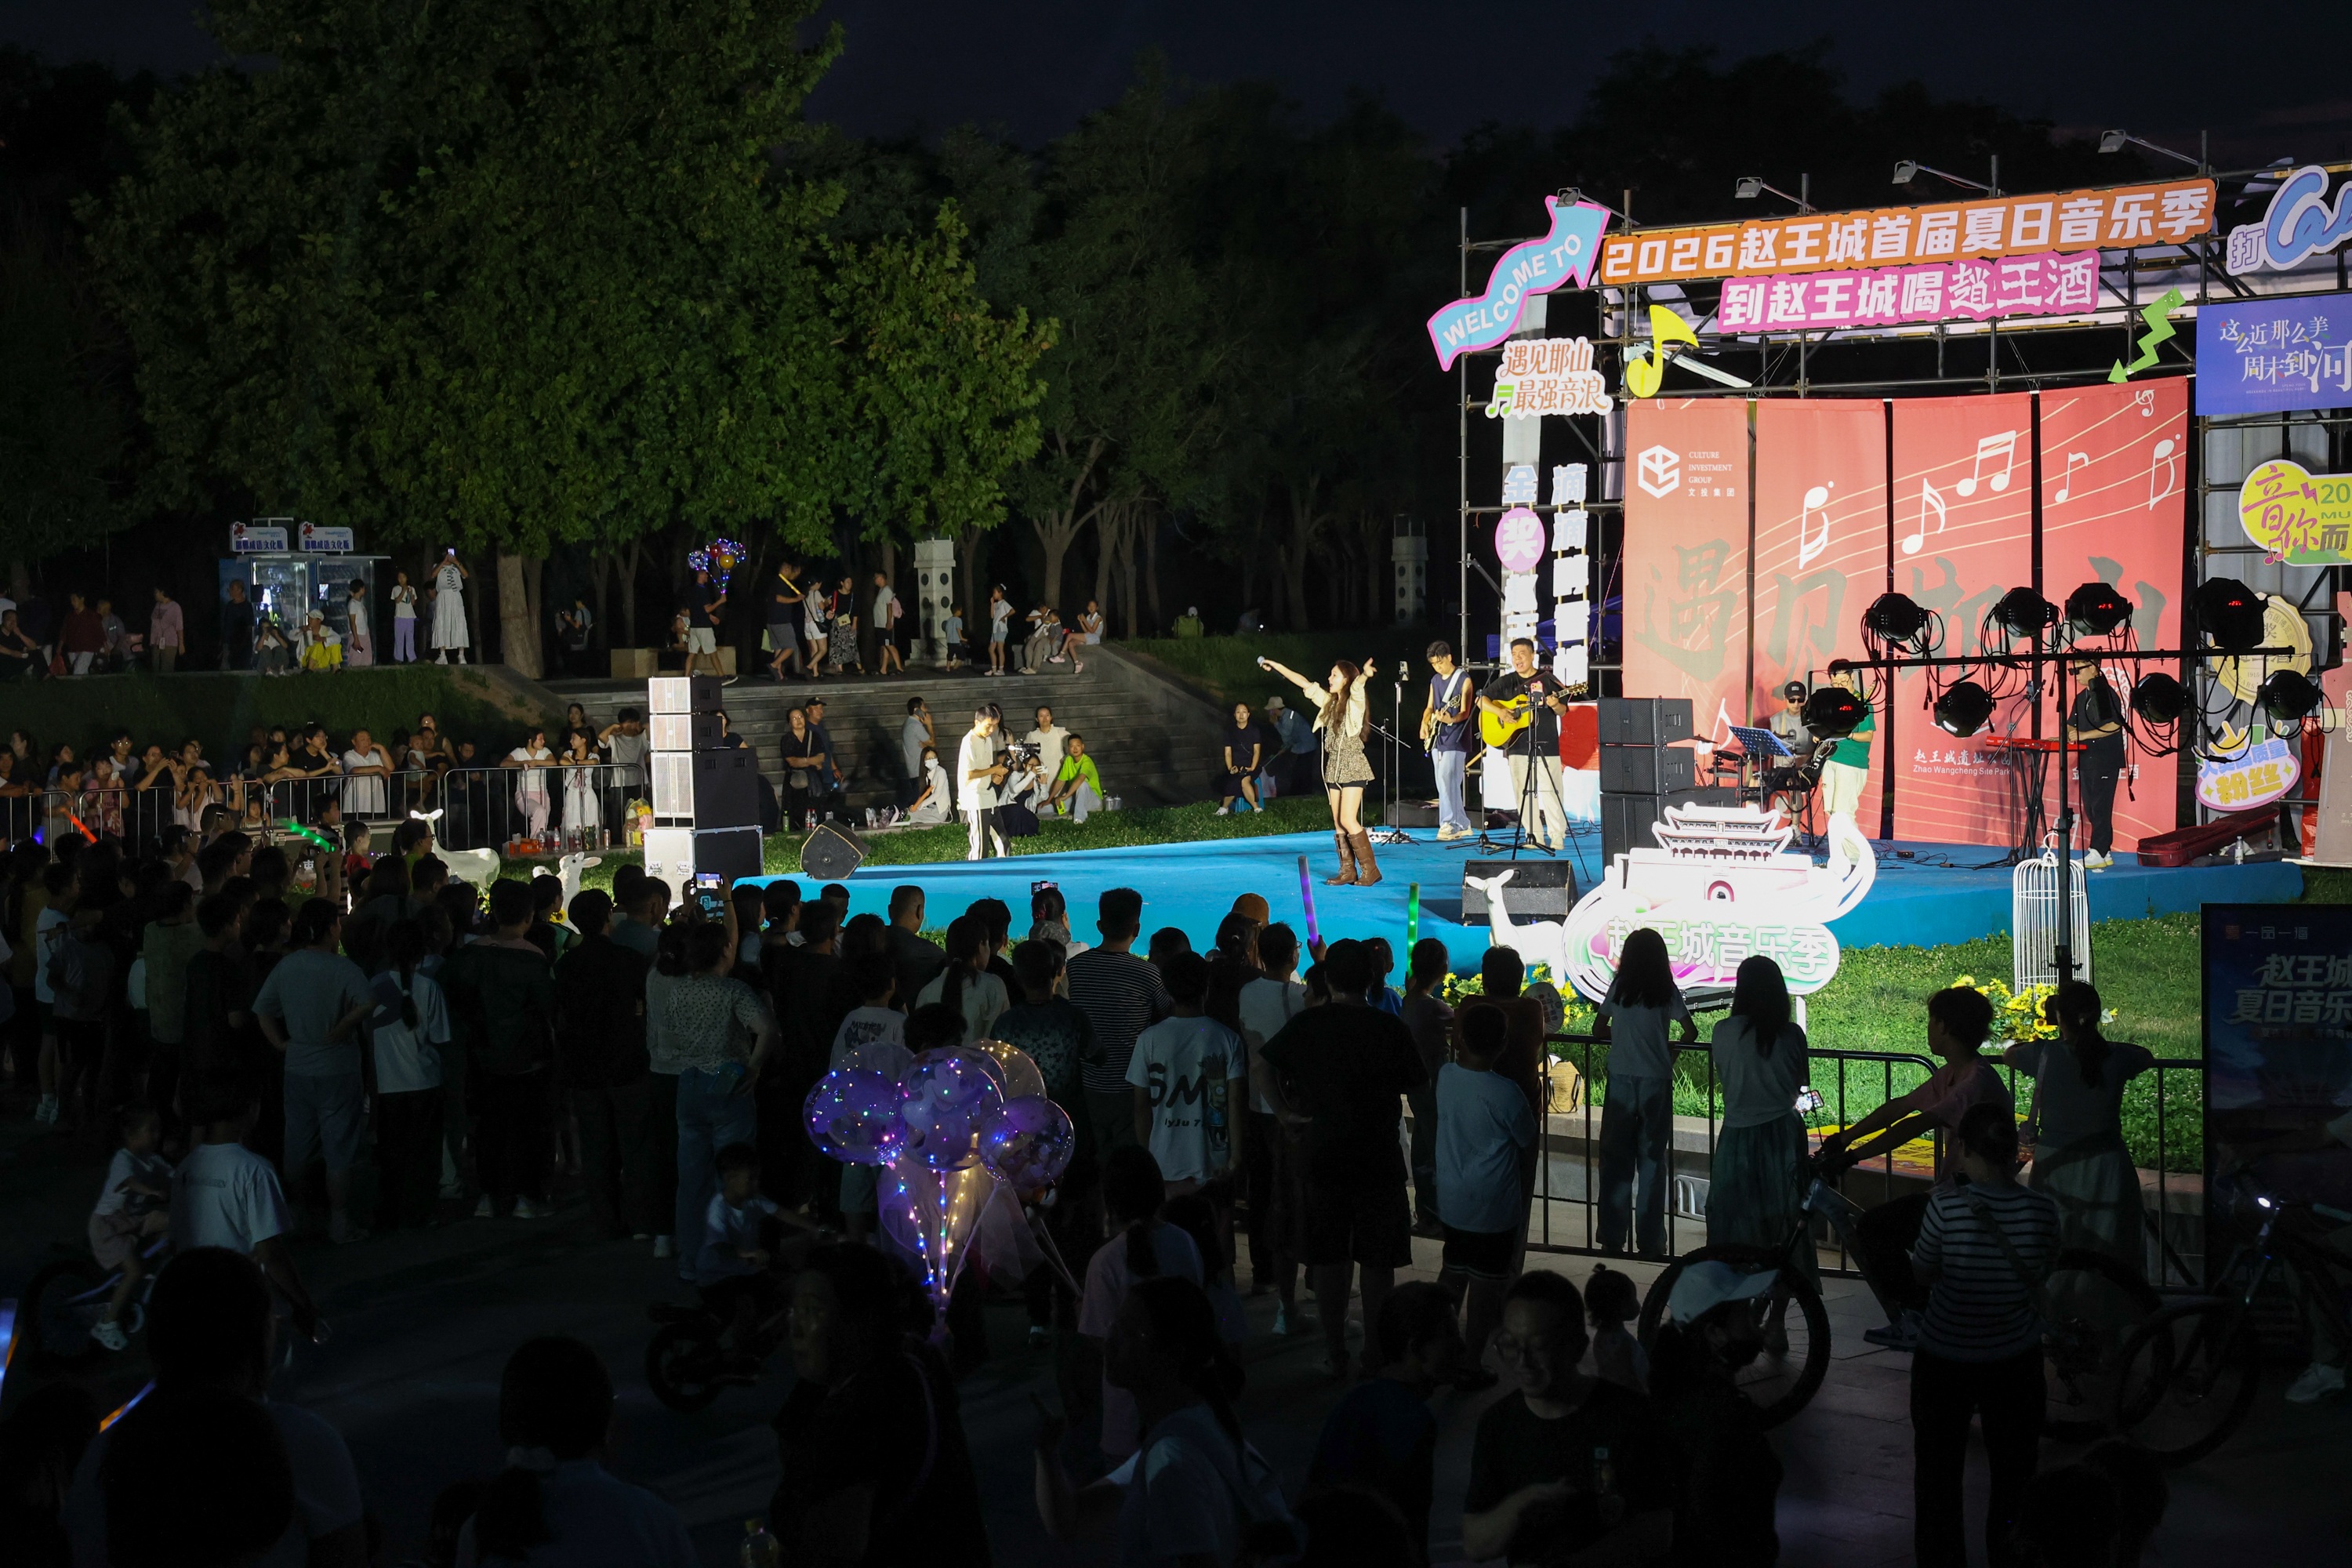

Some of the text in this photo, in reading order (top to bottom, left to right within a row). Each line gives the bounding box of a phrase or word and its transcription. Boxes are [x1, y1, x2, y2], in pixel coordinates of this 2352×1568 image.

[1605, 187, 2209, 278] 2026赵王城首届夏日音乐季
[1443, 234, 1581, 347] WELCOME TO
[1500, 343, 1589, 378] 遇见邯山
[1514, 376, 1608, 413] 最强音浪
[1913, 764, 2011, 776] Zhao Wangcheng Site Park
[2216, 764, 2283, 804] 粉丝
